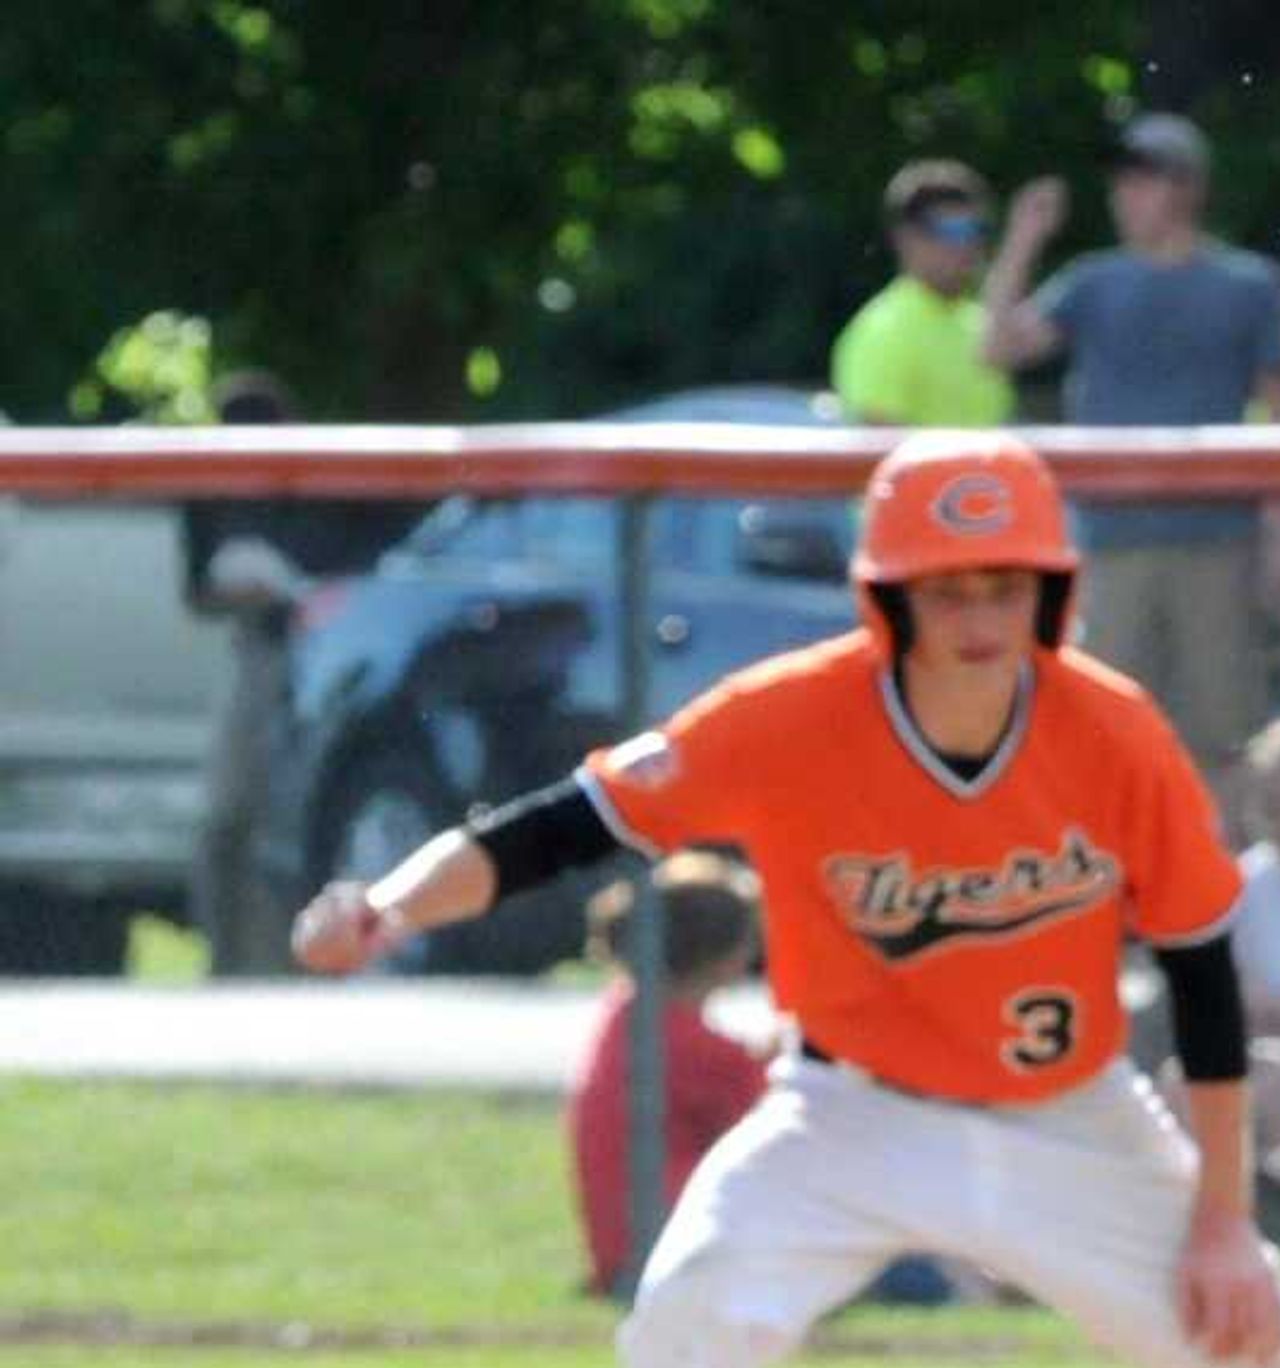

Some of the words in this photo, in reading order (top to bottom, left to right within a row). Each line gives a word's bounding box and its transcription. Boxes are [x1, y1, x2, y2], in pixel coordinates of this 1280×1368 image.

[931, 475, 1014, 534] C
[823, 828, 1124, 955] Tigers
[1007, 989, 1080, 1072] 3
